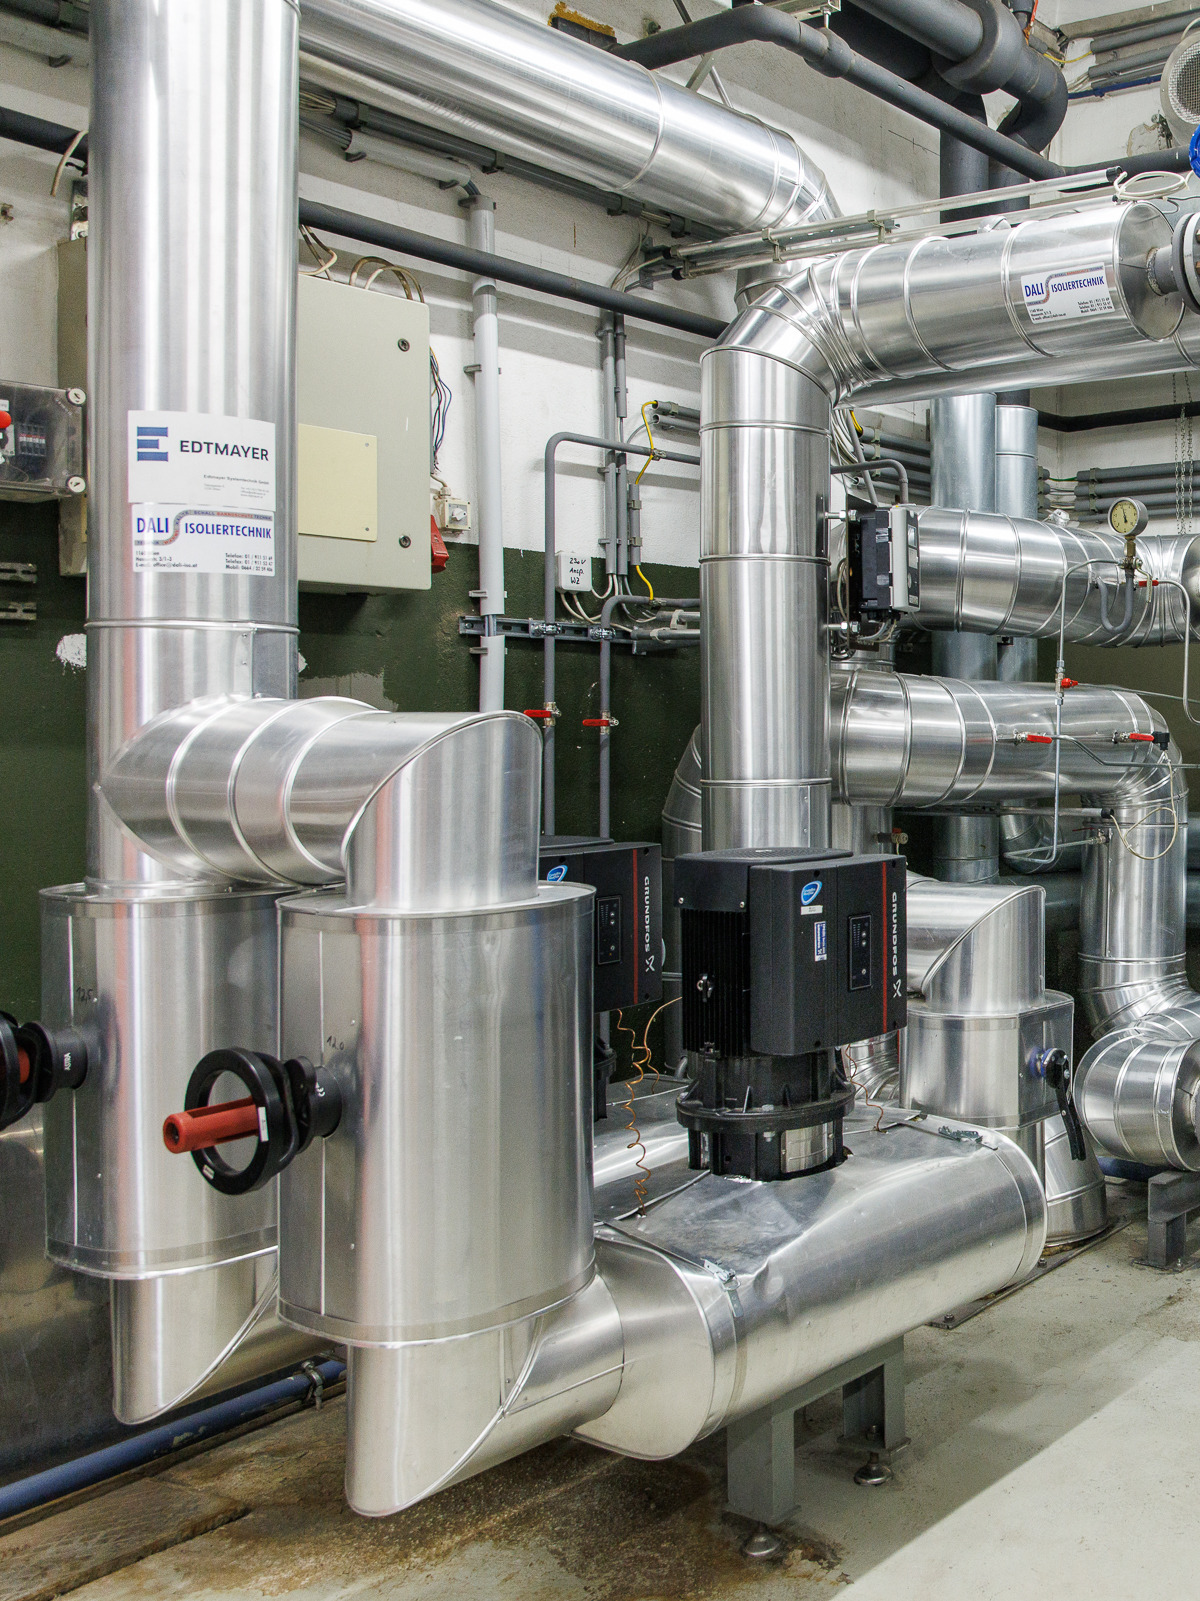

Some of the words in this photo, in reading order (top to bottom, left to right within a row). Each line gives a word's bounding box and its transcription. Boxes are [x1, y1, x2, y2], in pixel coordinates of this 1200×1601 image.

[1024, 282, 1045, 297] DALI
[1051, 275, 1105, 293] ISOLIERTECHNIK
[179, 439, 269, 461] EDTMAYER
[136, 517, 169, 533] DALI
[184, 522, 272, 539] ISOLIERTECHNIK
